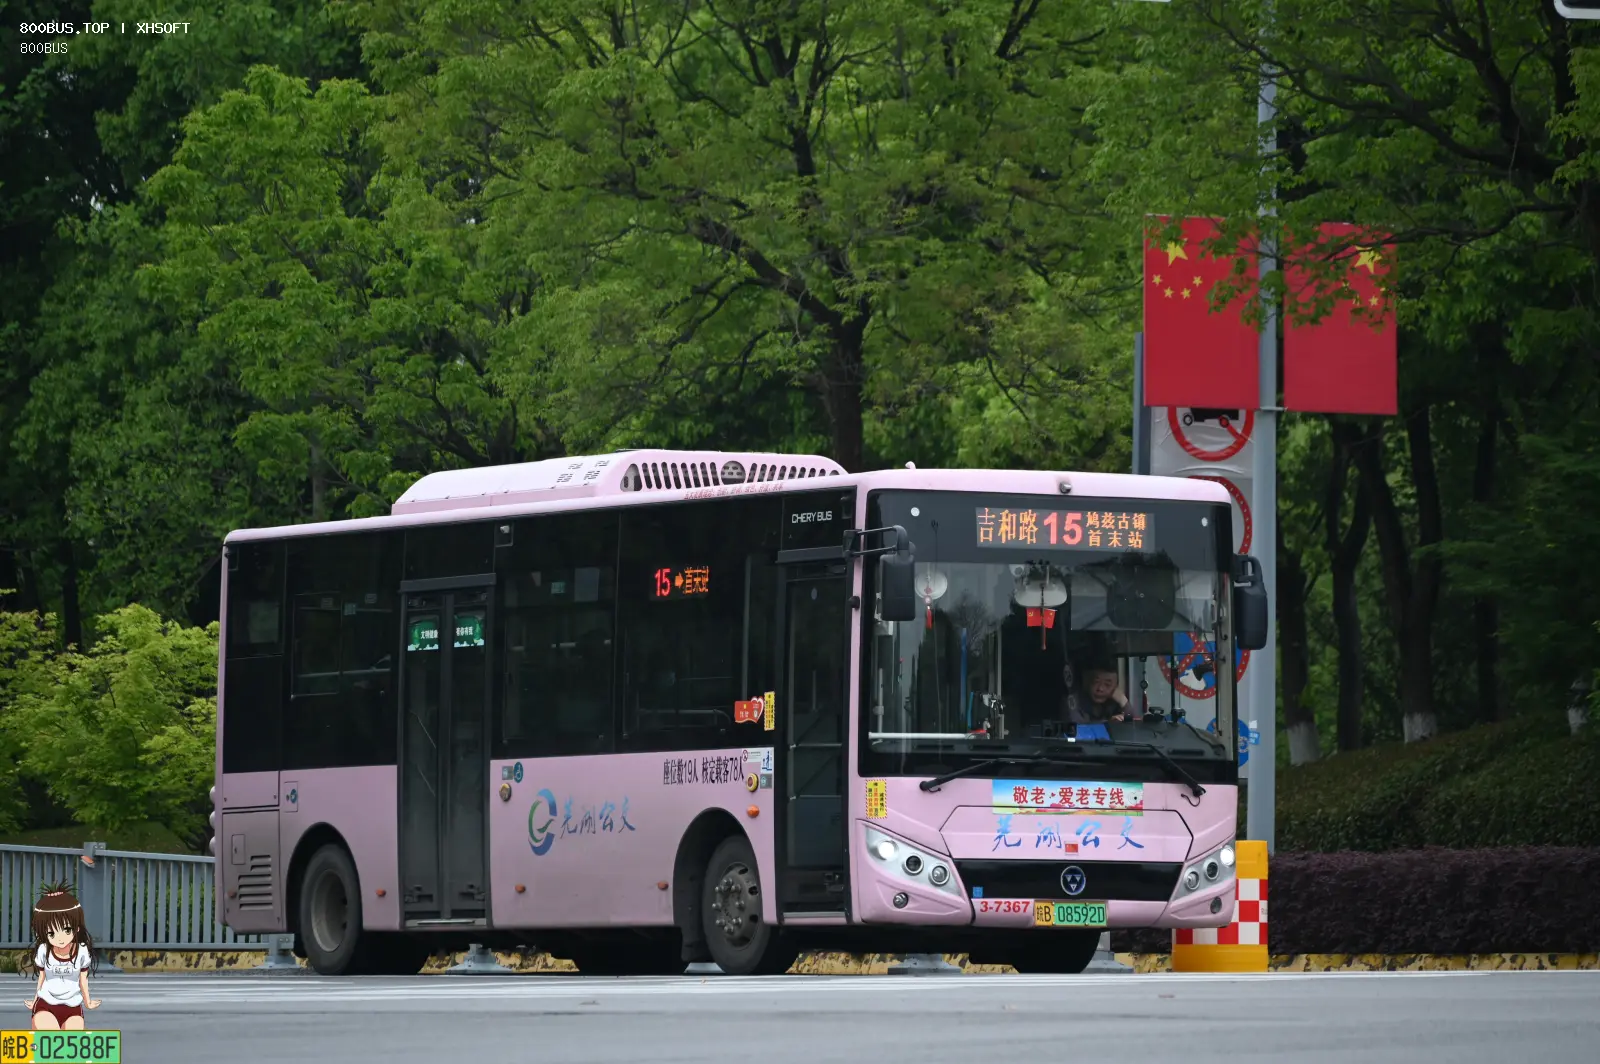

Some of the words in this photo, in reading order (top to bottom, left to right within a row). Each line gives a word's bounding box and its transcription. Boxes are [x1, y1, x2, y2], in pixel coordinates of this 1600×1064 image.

[791, 513, 817, 524] CHERY
[817, 510, 833, 522] BUS
[977, 507, 1039, 545] 吉和路
[1043, 512, 1084, 545] 15
[1087, 530, 1143, 549] 首末站
[654, 567, 671, 597] 15
[979, 900, 1031, 913] 3-7367
[1057, 905, 1106, 923] 08592D
